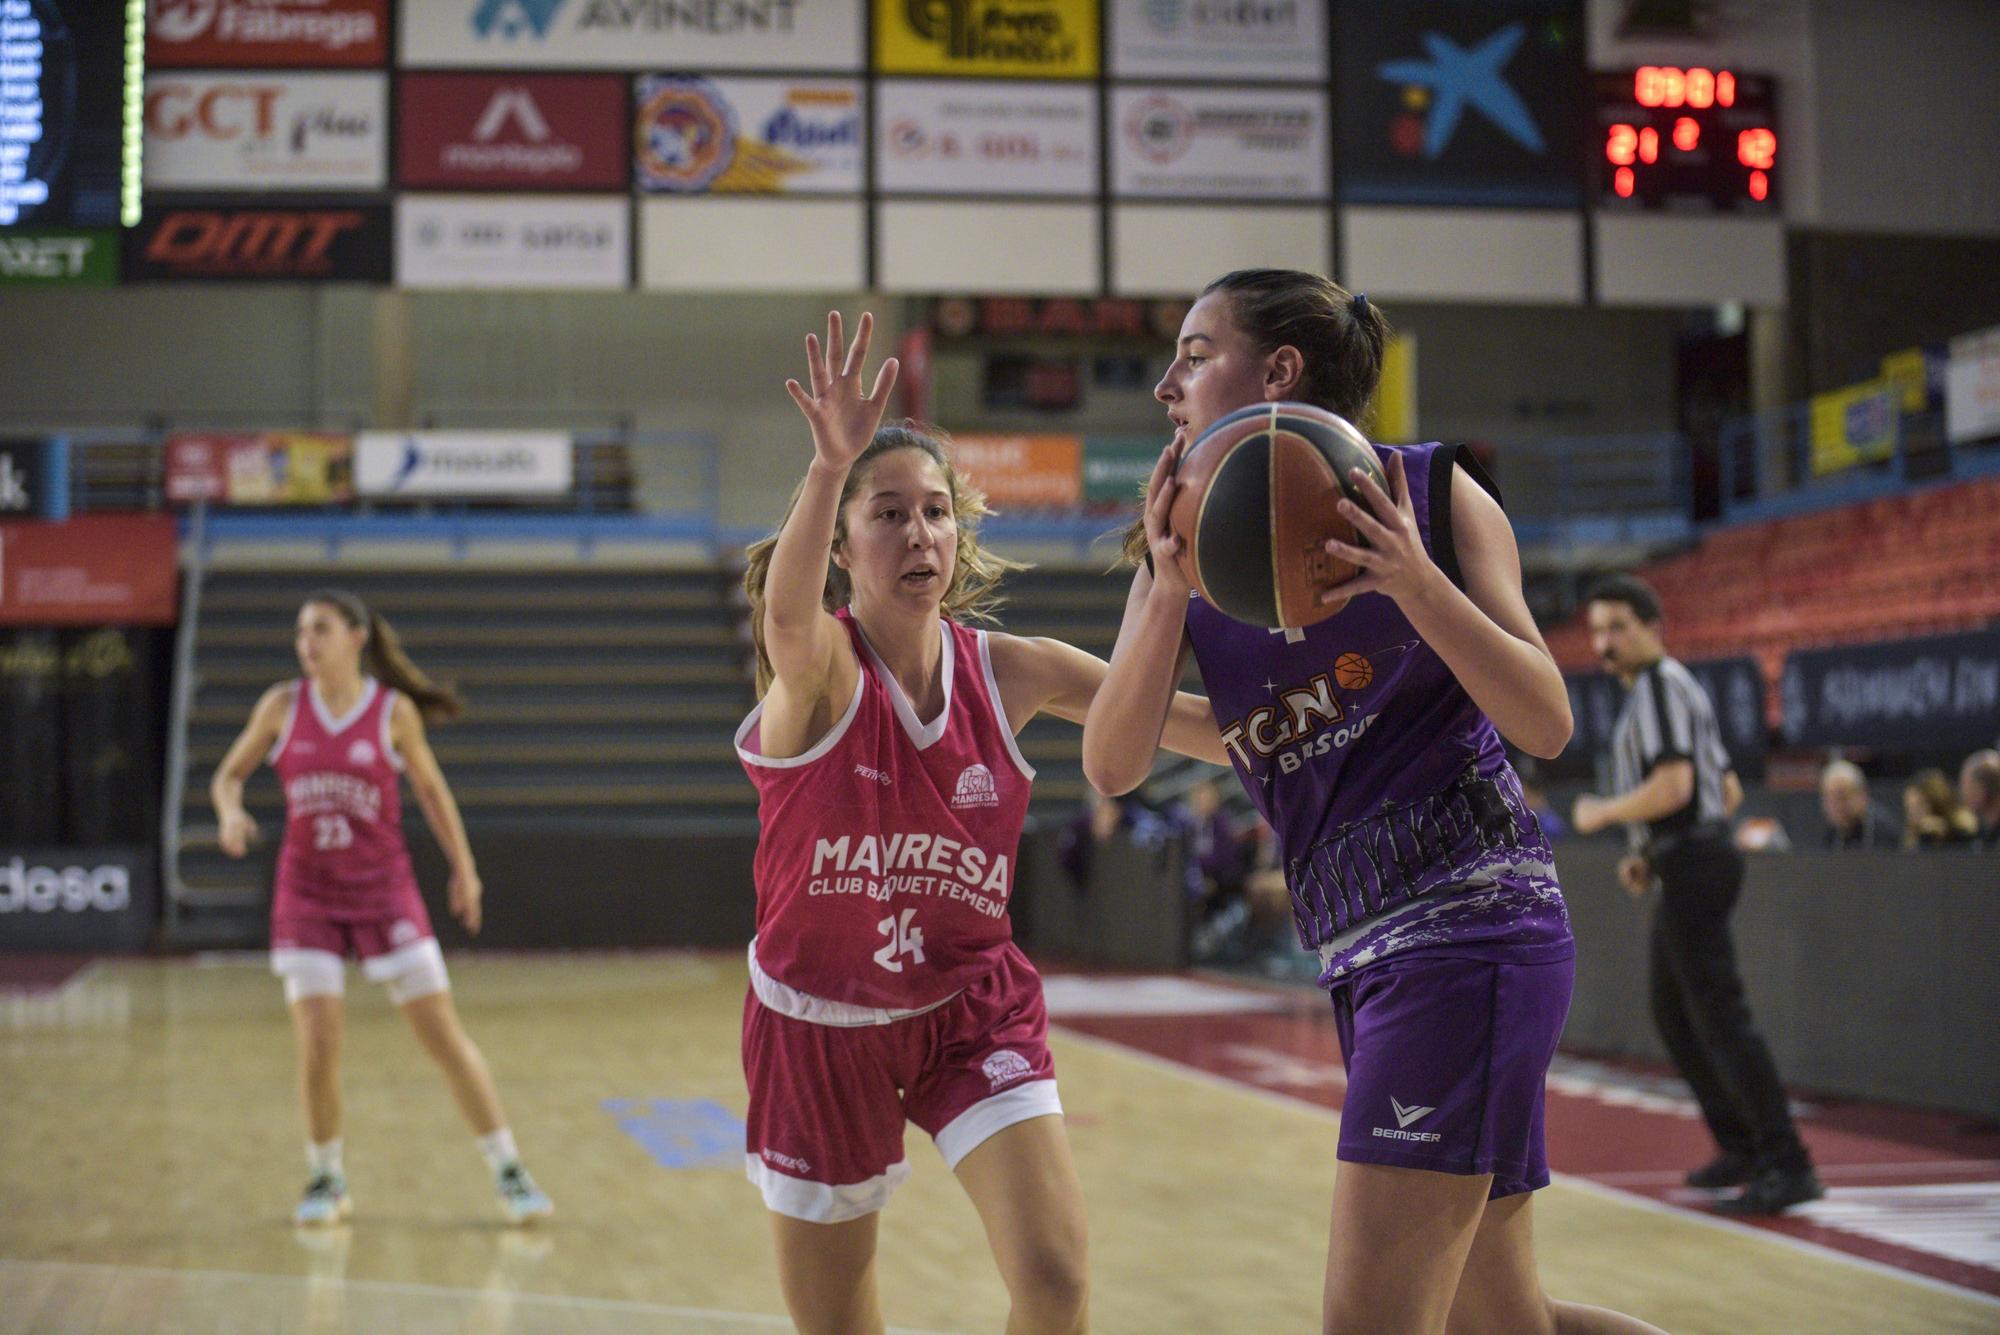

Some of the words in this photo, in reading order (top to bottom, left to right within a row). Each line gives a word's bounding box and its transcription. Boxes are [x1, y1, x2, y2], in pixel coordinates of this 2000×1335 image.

[142, 83, 288, 141] GCT
[1221, 673, 1344, 774] TGN
[951, 791, 999, 804] MANRESA
[808, 876, 862, 897] CLUB
[867, 874, 936, 902] BÀQUET
[873, 908, 926, 973] 24
[1372, 1127, 1441, 1142] BEMISER
